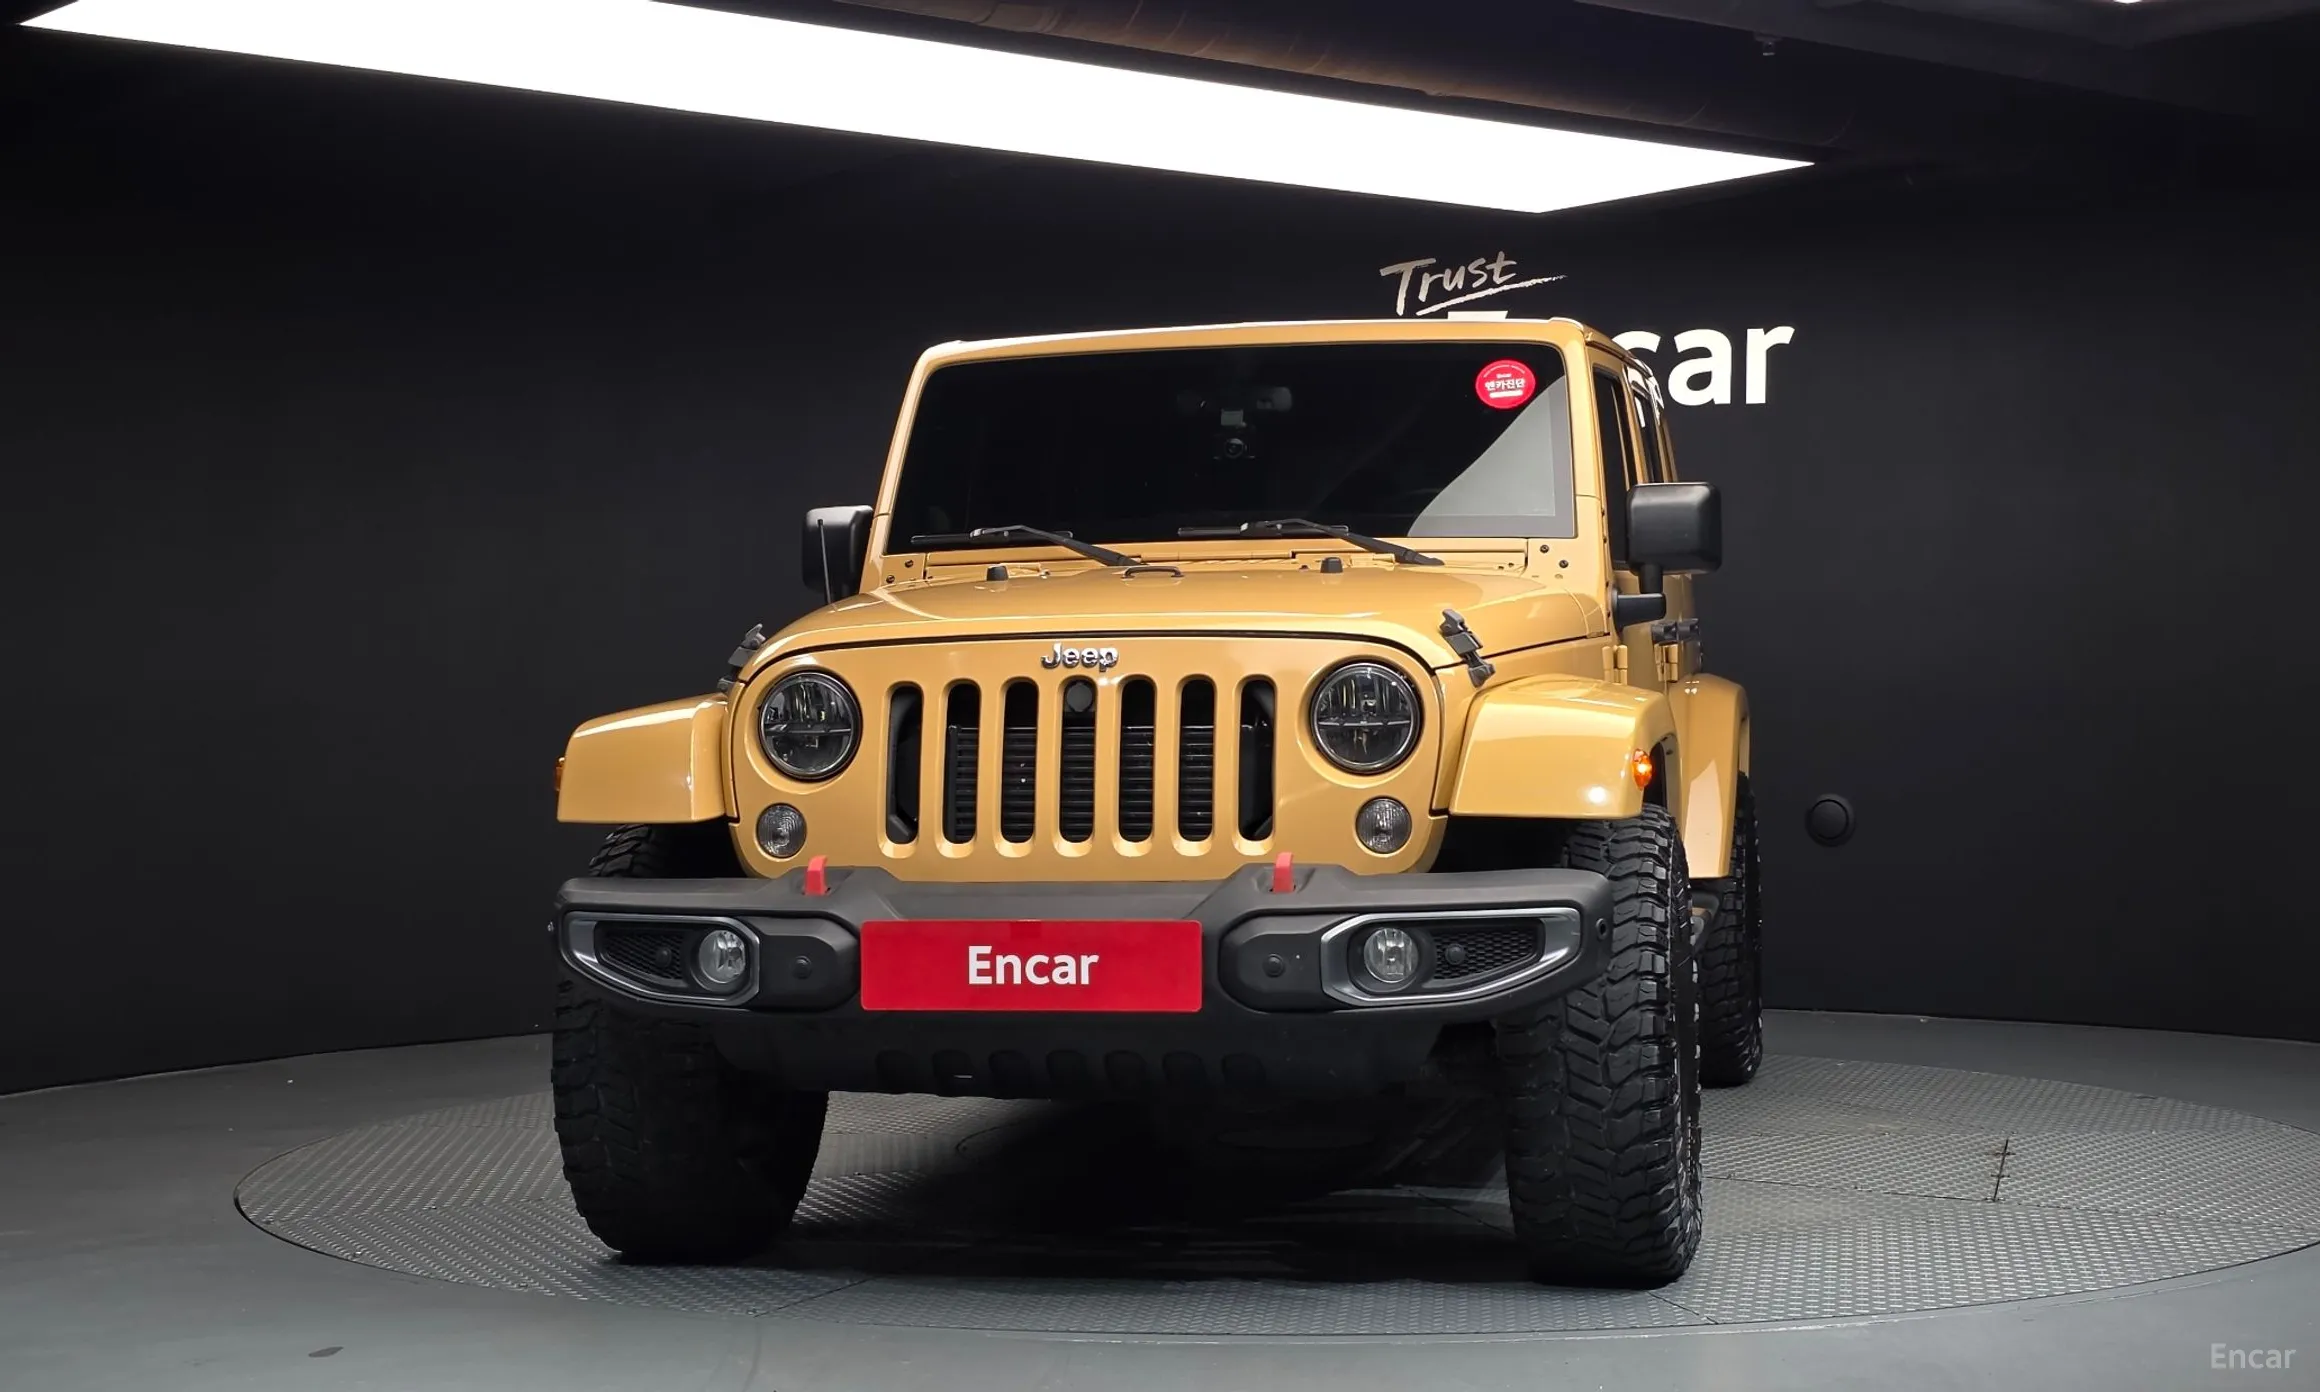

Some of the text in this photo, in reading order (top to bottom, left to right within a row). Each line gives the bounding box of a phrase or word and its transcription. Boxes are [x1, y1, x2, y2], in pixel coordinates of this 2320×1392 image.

[1379, 251, 1518, 316] Trust
[1040, 640, 1119, 673] Jeep
[968, 945, 1100, 985] Encar
